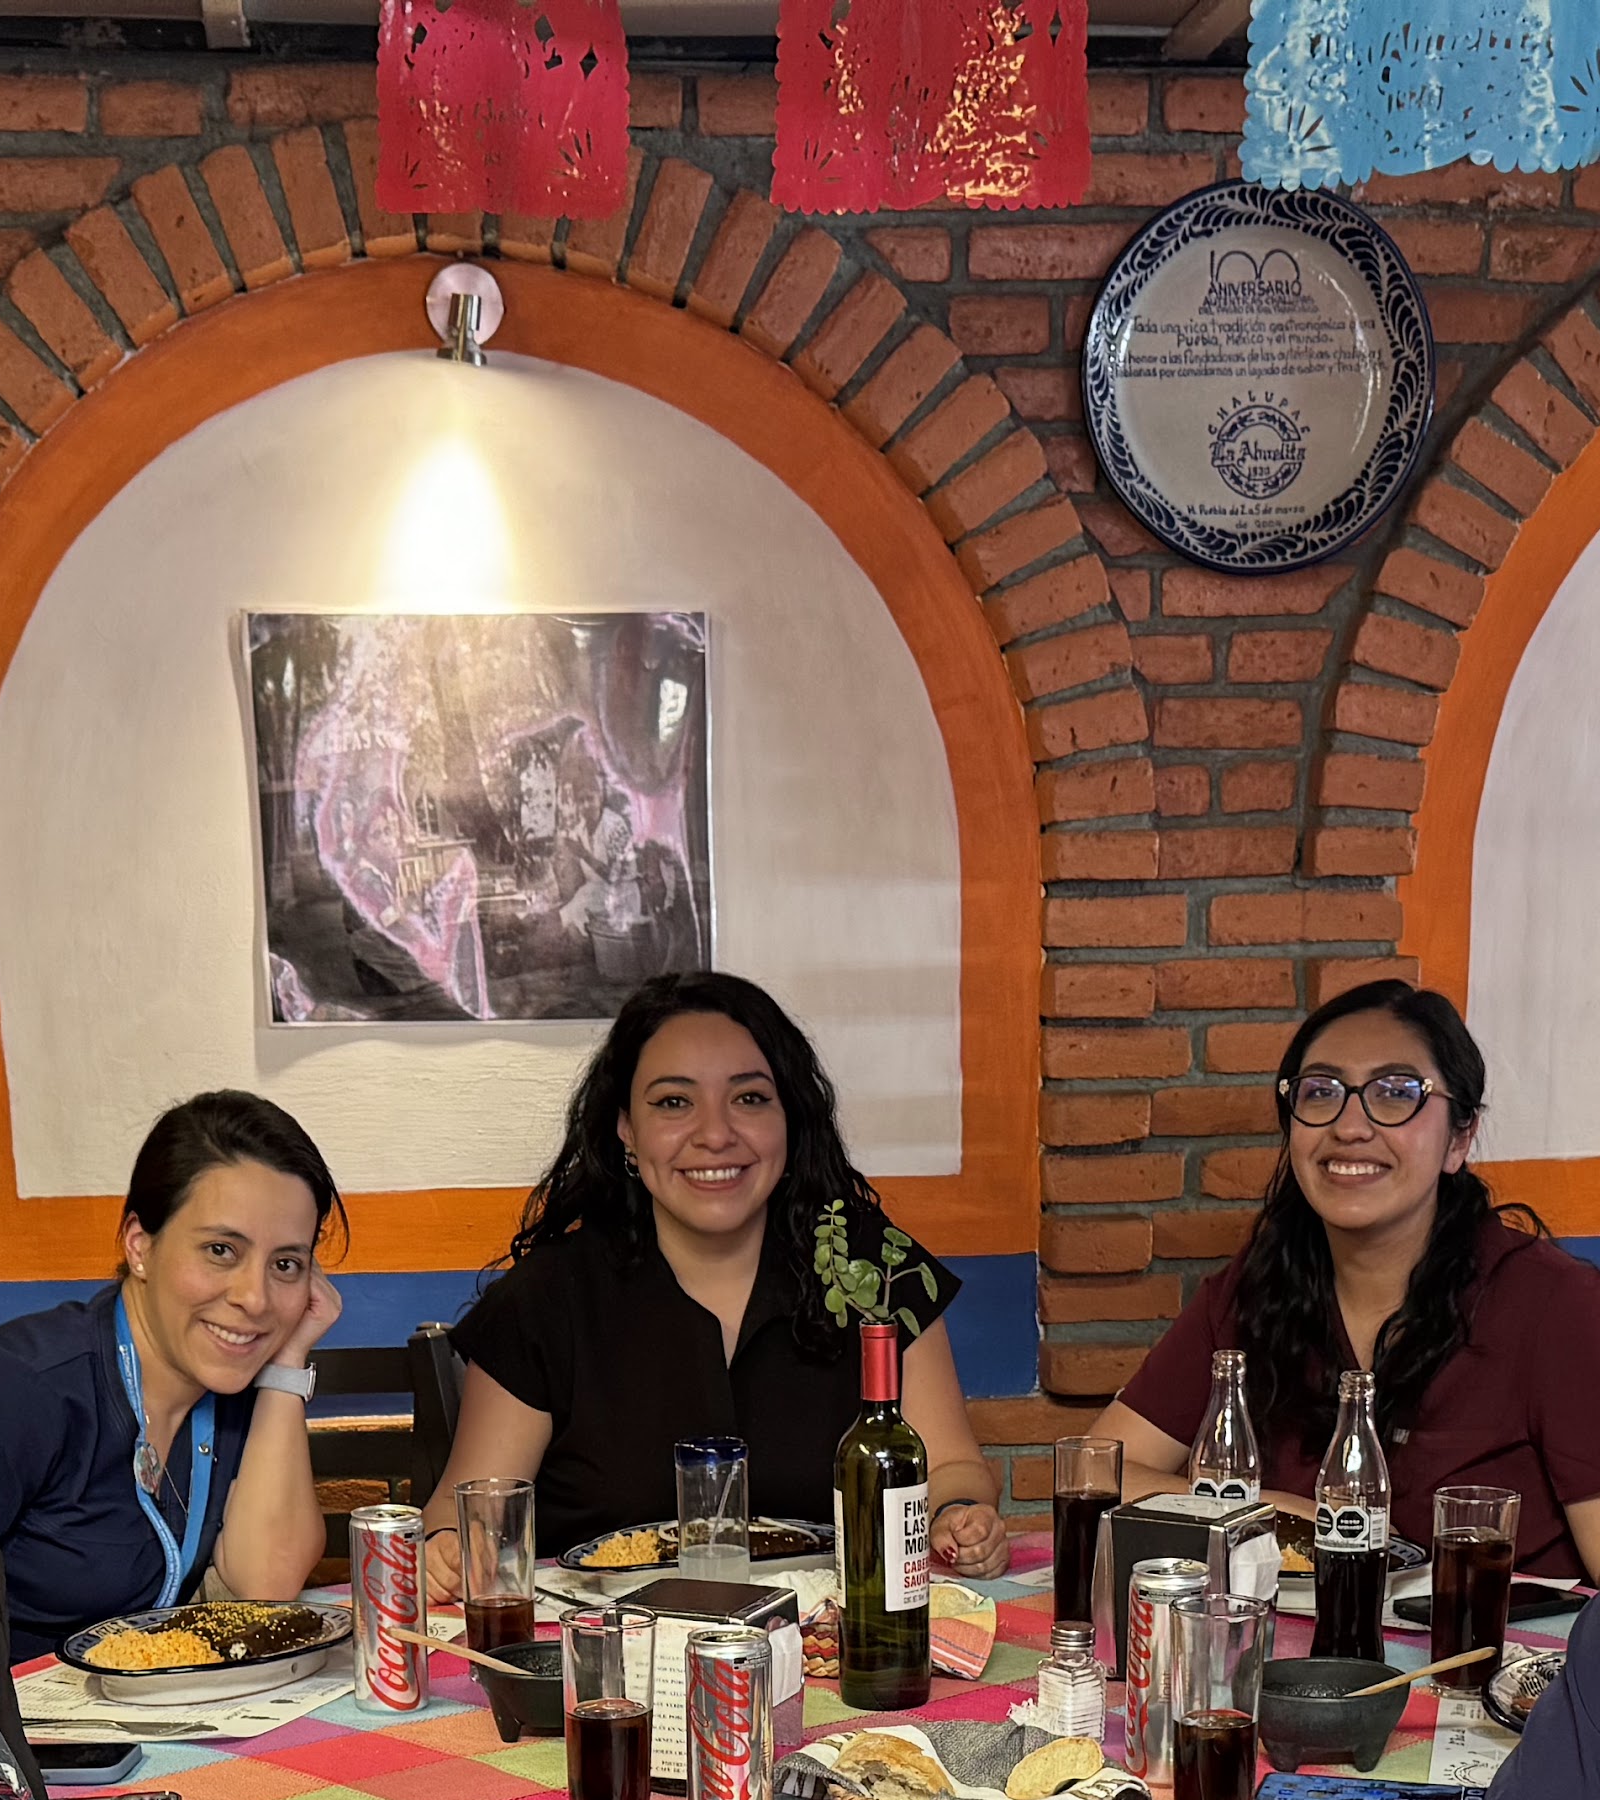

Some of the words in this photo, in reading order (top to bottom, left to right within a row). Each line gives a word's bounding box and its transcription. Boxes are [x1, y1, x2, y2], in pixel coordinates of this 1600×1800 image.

[1208, 280, 1303, 299] ANIVERSARIO
[1275, 332, 1286, 344] el
[903, 1516, 926, 1537] LAS
